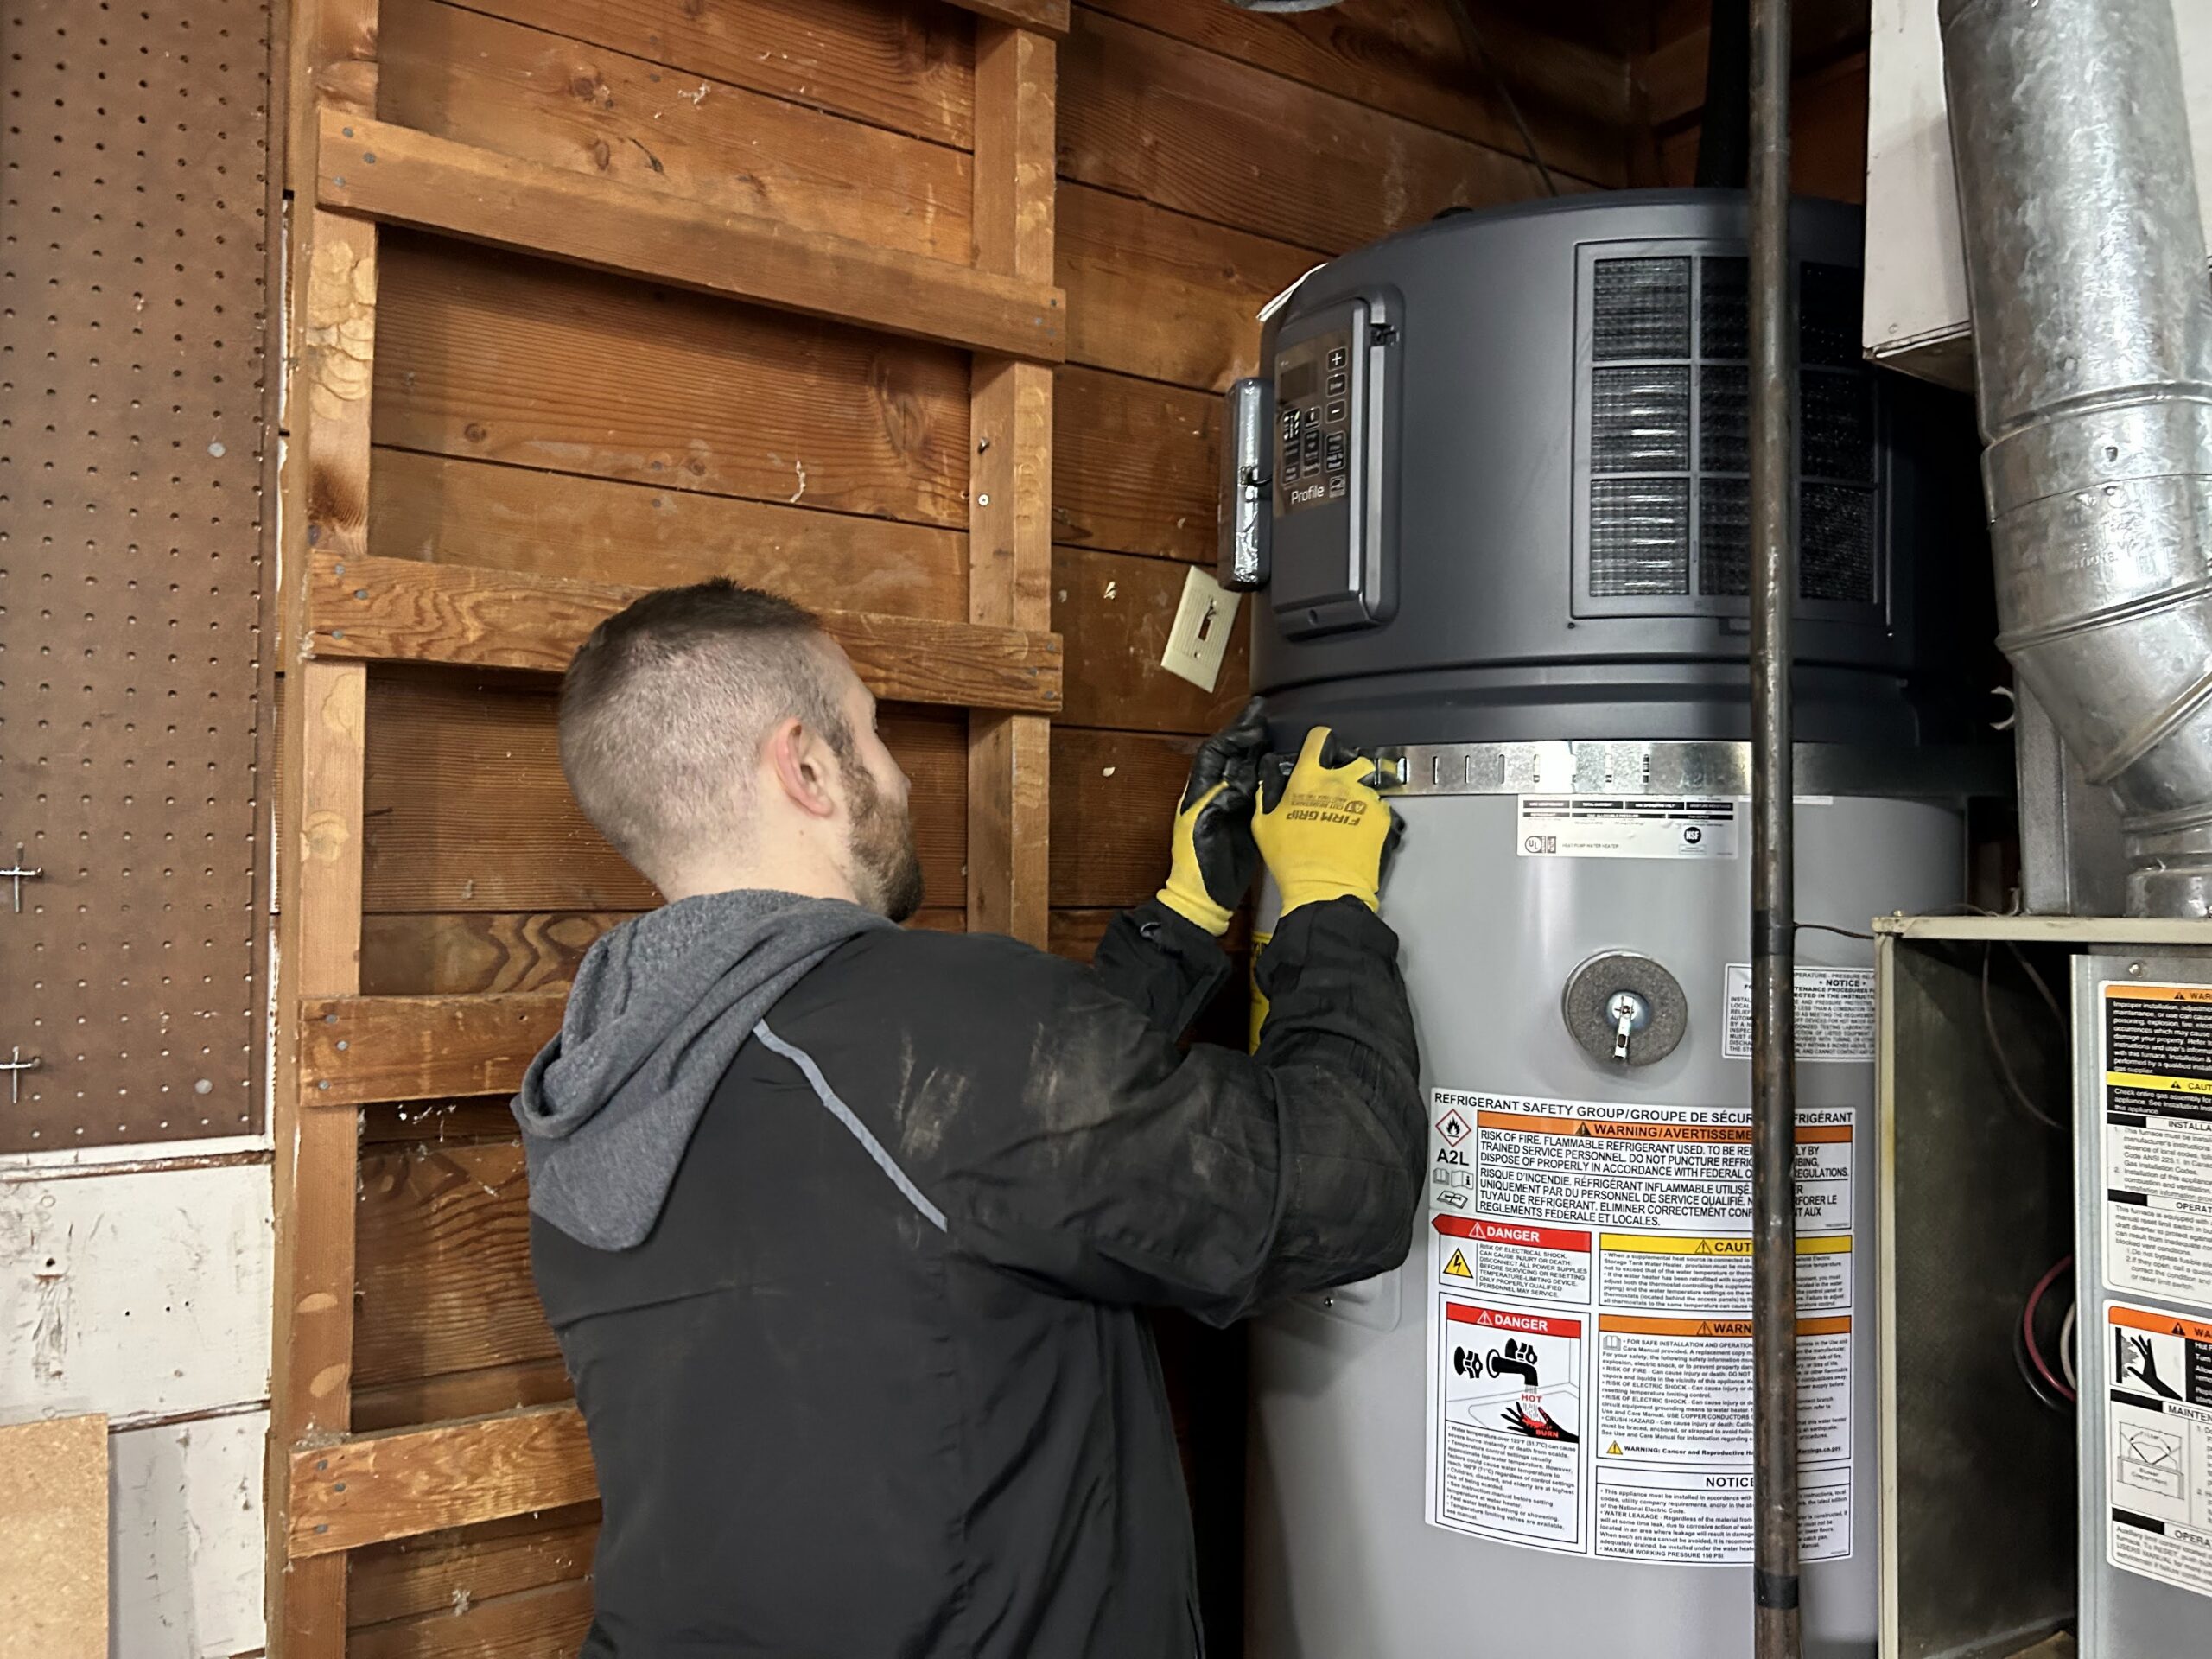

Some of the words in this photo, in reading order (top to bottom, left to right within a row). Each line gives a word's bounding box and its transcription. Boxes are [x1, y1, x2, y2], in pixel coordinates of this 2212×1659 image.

[1291, 486, 1325, 505] Profile
[1287, 810, 1319, 821] GRIP
[1320, 812, 1360, 825] FIRM
[1686, 830, 1700, 840] NSF
[1529, 840, 1538, 849] UL
[2188, 1083, 2212, 1091] CAUT
[1435, 1093, 1519, 1111] REFRIGERANT
[1522, 1102, 1573, 1116] SAFETY
[1577, 1107, 1687, 1122] GROUP/GROUPE
[1691, 1112, 1707, 1122] DE
[1712, 1110, 1751, 1123] SÉCUR
[1594, 1124, 1751, 1140] WARNING/AVERTISSEME
[2168, 1121, 2212, 1132] INSTALLA
[1481, 1130, 1502, 1141] RISK
[1504, 1133, 1516, 1142] OF
[1519, 1134, 1541, 1145] FIRE.
[1544, 1136, 1604, 1150] FLAMMABLE
[1606, 1141, 1675, 1154] REFRIGERANT
[1677, 1145, 1706, 1155] USED.
[1707, 1146, 1720, 1155] TO
[1723, 1146, 1735, 1155] BE
[1808, 1146, 1819, 1155] BY
[1437, 1148, 1469, 1166] A2L
[1481, 1141, 1520, 1154] TRAINED
[1522, 1145, 1562, 1158] SERVICE
[1566, 1149, 1626, 1162] PERSONNEL.
[1630, 1154, 1642, 1164] DO
[1646, 1155, 1666, 1165] NOT
[1669, 1156, 1719, 1166] PUNCTURE
[1481, 1152, 1519, 1165] DISPOSE
[1522, 1156, 1535, 1166] OF
[1537, 1158, 1590, 1172] PROPERLY
[1592, 1162, 1600, 1172] IN
[1603, 1165, 1672, 1177] ACCORDANCE
[1675, 1168, 1698, 1177] WITH
[1700, 1168, 1744, 1178] FEDERAL
[1480, 1168, 1514, 1181] RISQUE
[1574, 1175, 1643, 1192] RÉFRIGÉRANT
[1645, 1182, 1713, 1194] INFLAMMABLE
[1480, 1179, 1541, 1195] UNIQUEMENT
[1543, 1186, 1562, 1197] PAR
[1565, 1189, 1580, 1198] DU
[1581, 1191, 1640, 1203] PERSONNEL
[1643, 1193, 1656, 1203] DE
[1658, 1194, 1699, 1205] SERVICE
[1827, 1195, 1837, 1205] LE
[1480, 1190, 1510, 1203] TUYAU
[1512, 1193, 1525, 1204] DE
[1804, 1207, 1821, 1217] AUX
[2176, 1202, 2212, 1213] OPERAT
[1480, 1201, 1542, 1217] REGLEMENTS
[1599, 1213, 1611, 1223] ET
[1612, 1214, 1661, 1226] LOCALES.
[1486, 1226, 1540, 1243] DANGER
[1504, 1247, 1541, 1256] ELECTRICAL
[1715, 1242, 1751, 1252] CAUT
[1479, 1257, 1517, 1267] DISCONNECT
[1532, 1262, 1555, 1271] POWER
[1479, 1269, 1551, 1283] TEMPERATURE-LIMITING
[1505, 1266, 1537, 1275] SERVICING
[1549, 1271, 1585, 1281] RESETTING
[1479, 1282, 1515, 1293] PERSONNEL
[1497, 1277, 1528, 1287] PROPERLY
[1529, 1281, 1562, 1292] QUALIFIED
[1494, 1314, 1548, 1332] DANGER
[1713, 1324, 1751, 1333] WARN
[1522, 1394, 1542, 1402] HOT
[2168, 1405, 2212, 1422] MAINTEN
[1535, 1428, 1559, 1438] BURN
[2175, 1530, 2211, 1547] OPERA
